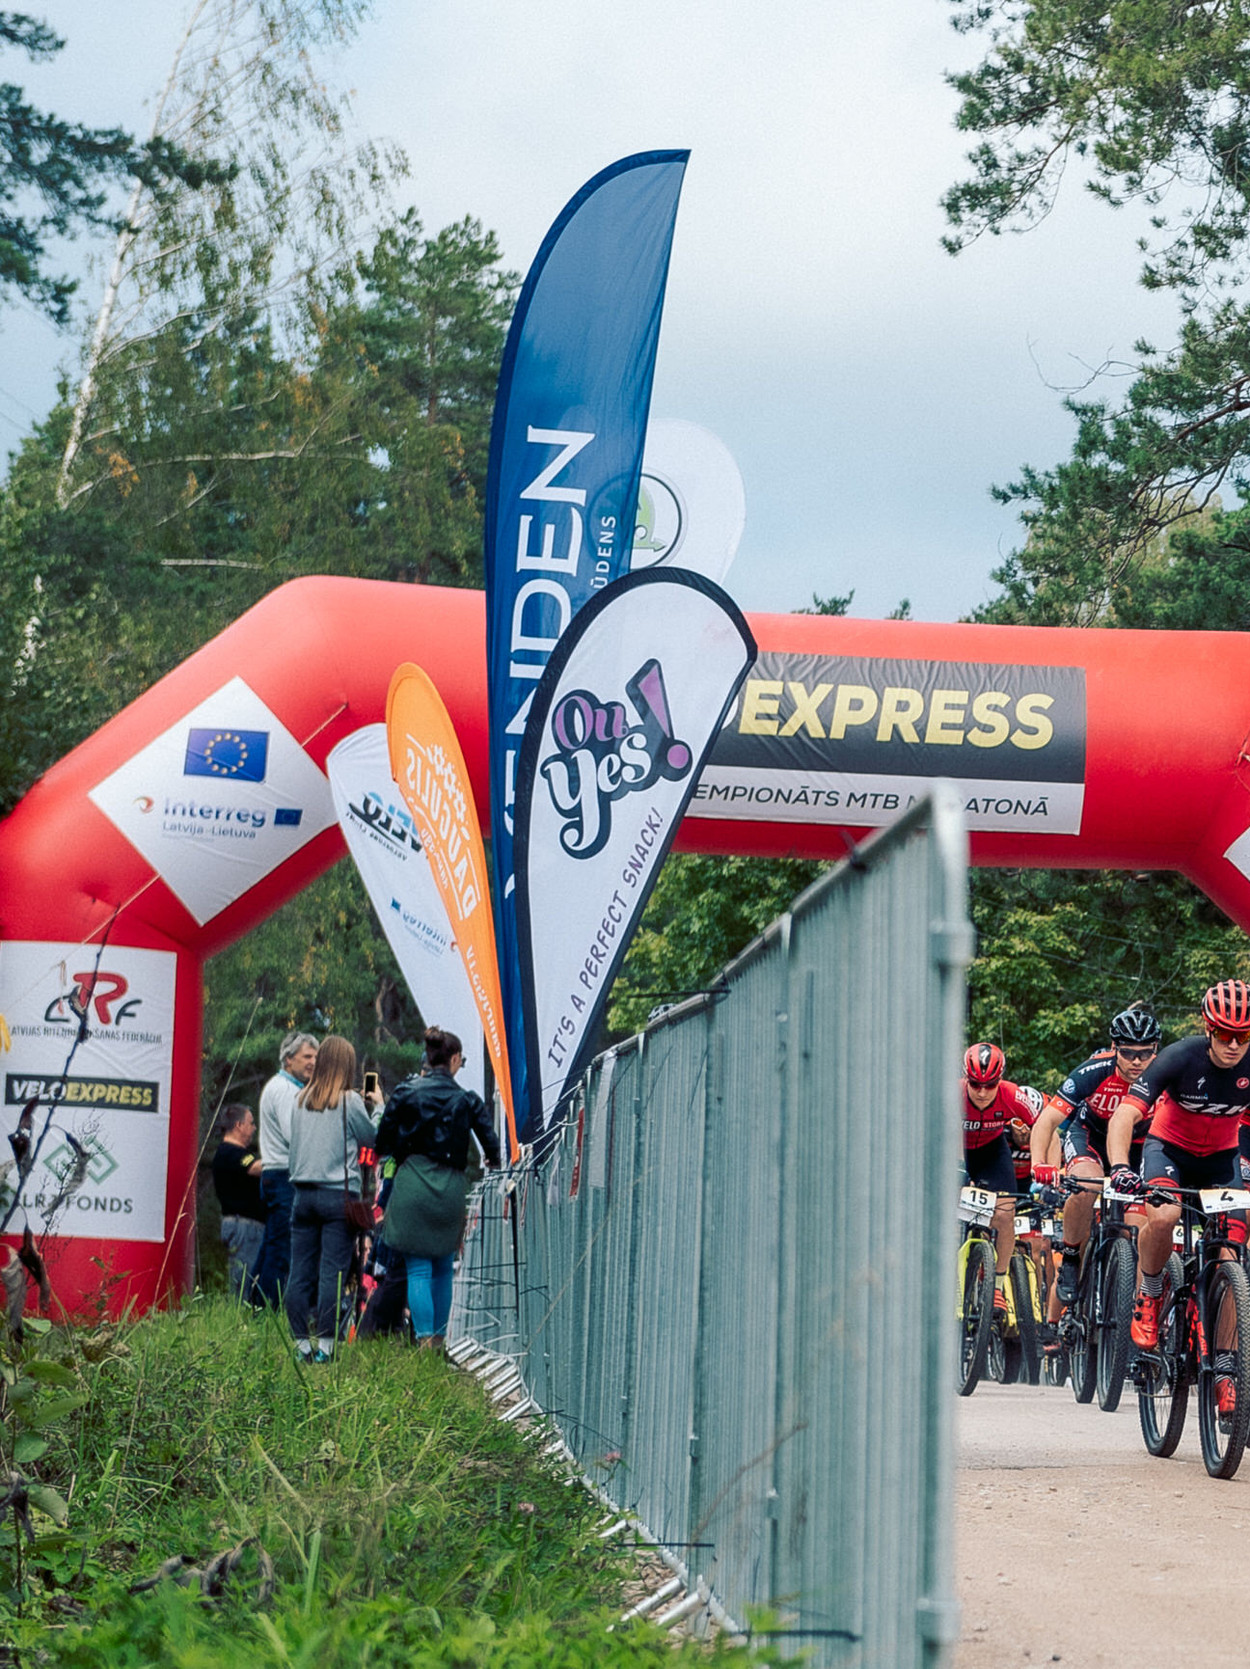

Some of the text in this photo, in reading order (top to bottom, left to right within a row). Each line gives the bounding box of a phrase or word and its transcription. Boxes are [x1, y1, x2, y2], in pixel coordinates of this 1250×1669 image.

[590, 514, 617, 589] ŪDENS
[722, 679, 1056, 750] EXPRESS
[694, 783, 841, 808] EMPIONĀTS
[846, 791, 900, 810] MTB
[163, 796, 266, 829] Interreg
[547, 807, 665, 1069] IT'S A PERFECT SNACK!
[1078, 1060, 1113, 1075] TREK
[65, 1195, 133, 1214] FONDS
[969, 1190, 989, 1206] 15
[1220, 1190, 1234, 1202] 4
